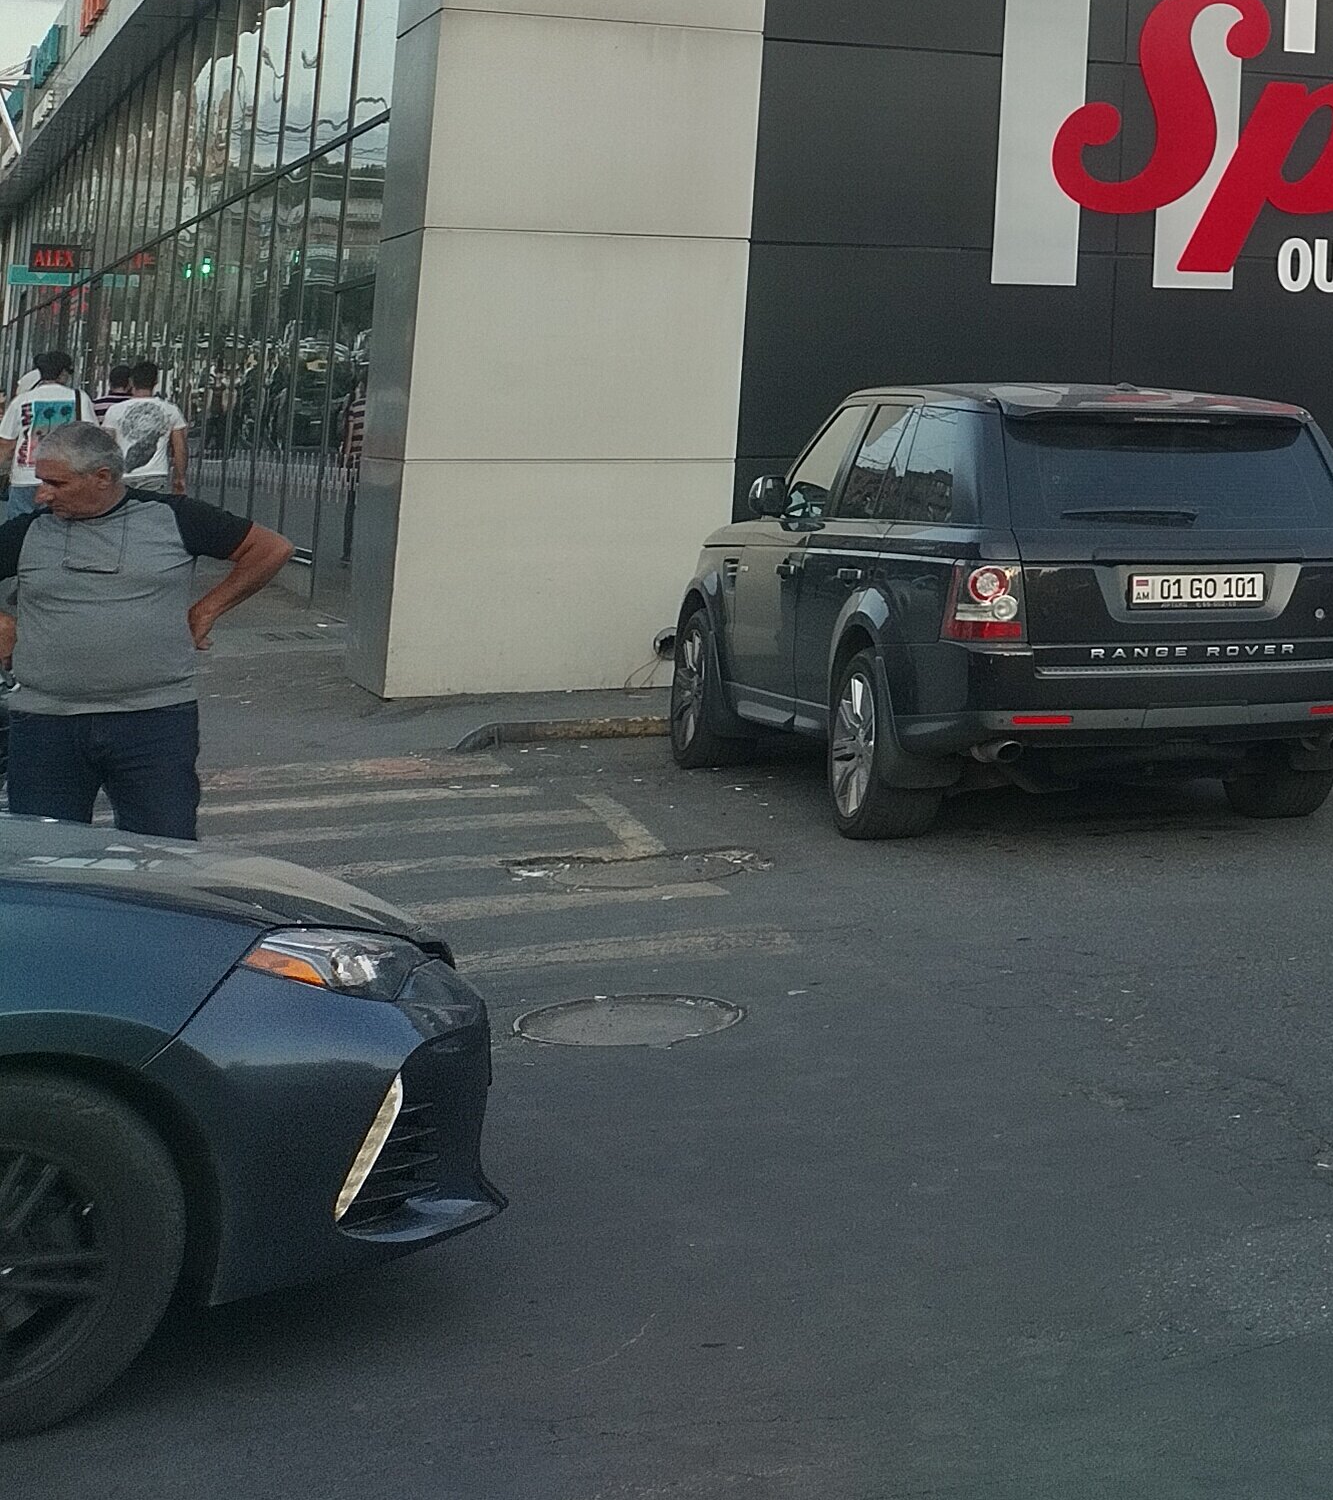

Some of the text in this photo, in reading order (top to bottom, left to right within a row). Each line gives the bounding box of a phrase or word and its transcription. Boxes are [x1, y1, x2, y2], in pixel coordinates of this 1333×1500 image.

[34, 249, 75, 267] ALEX
[1135, 592, 1150, 601] AM
[1160, 577, 1257, 600] 01 GO 101
[1090, 643, 1295, 659] RANGE ROVER
